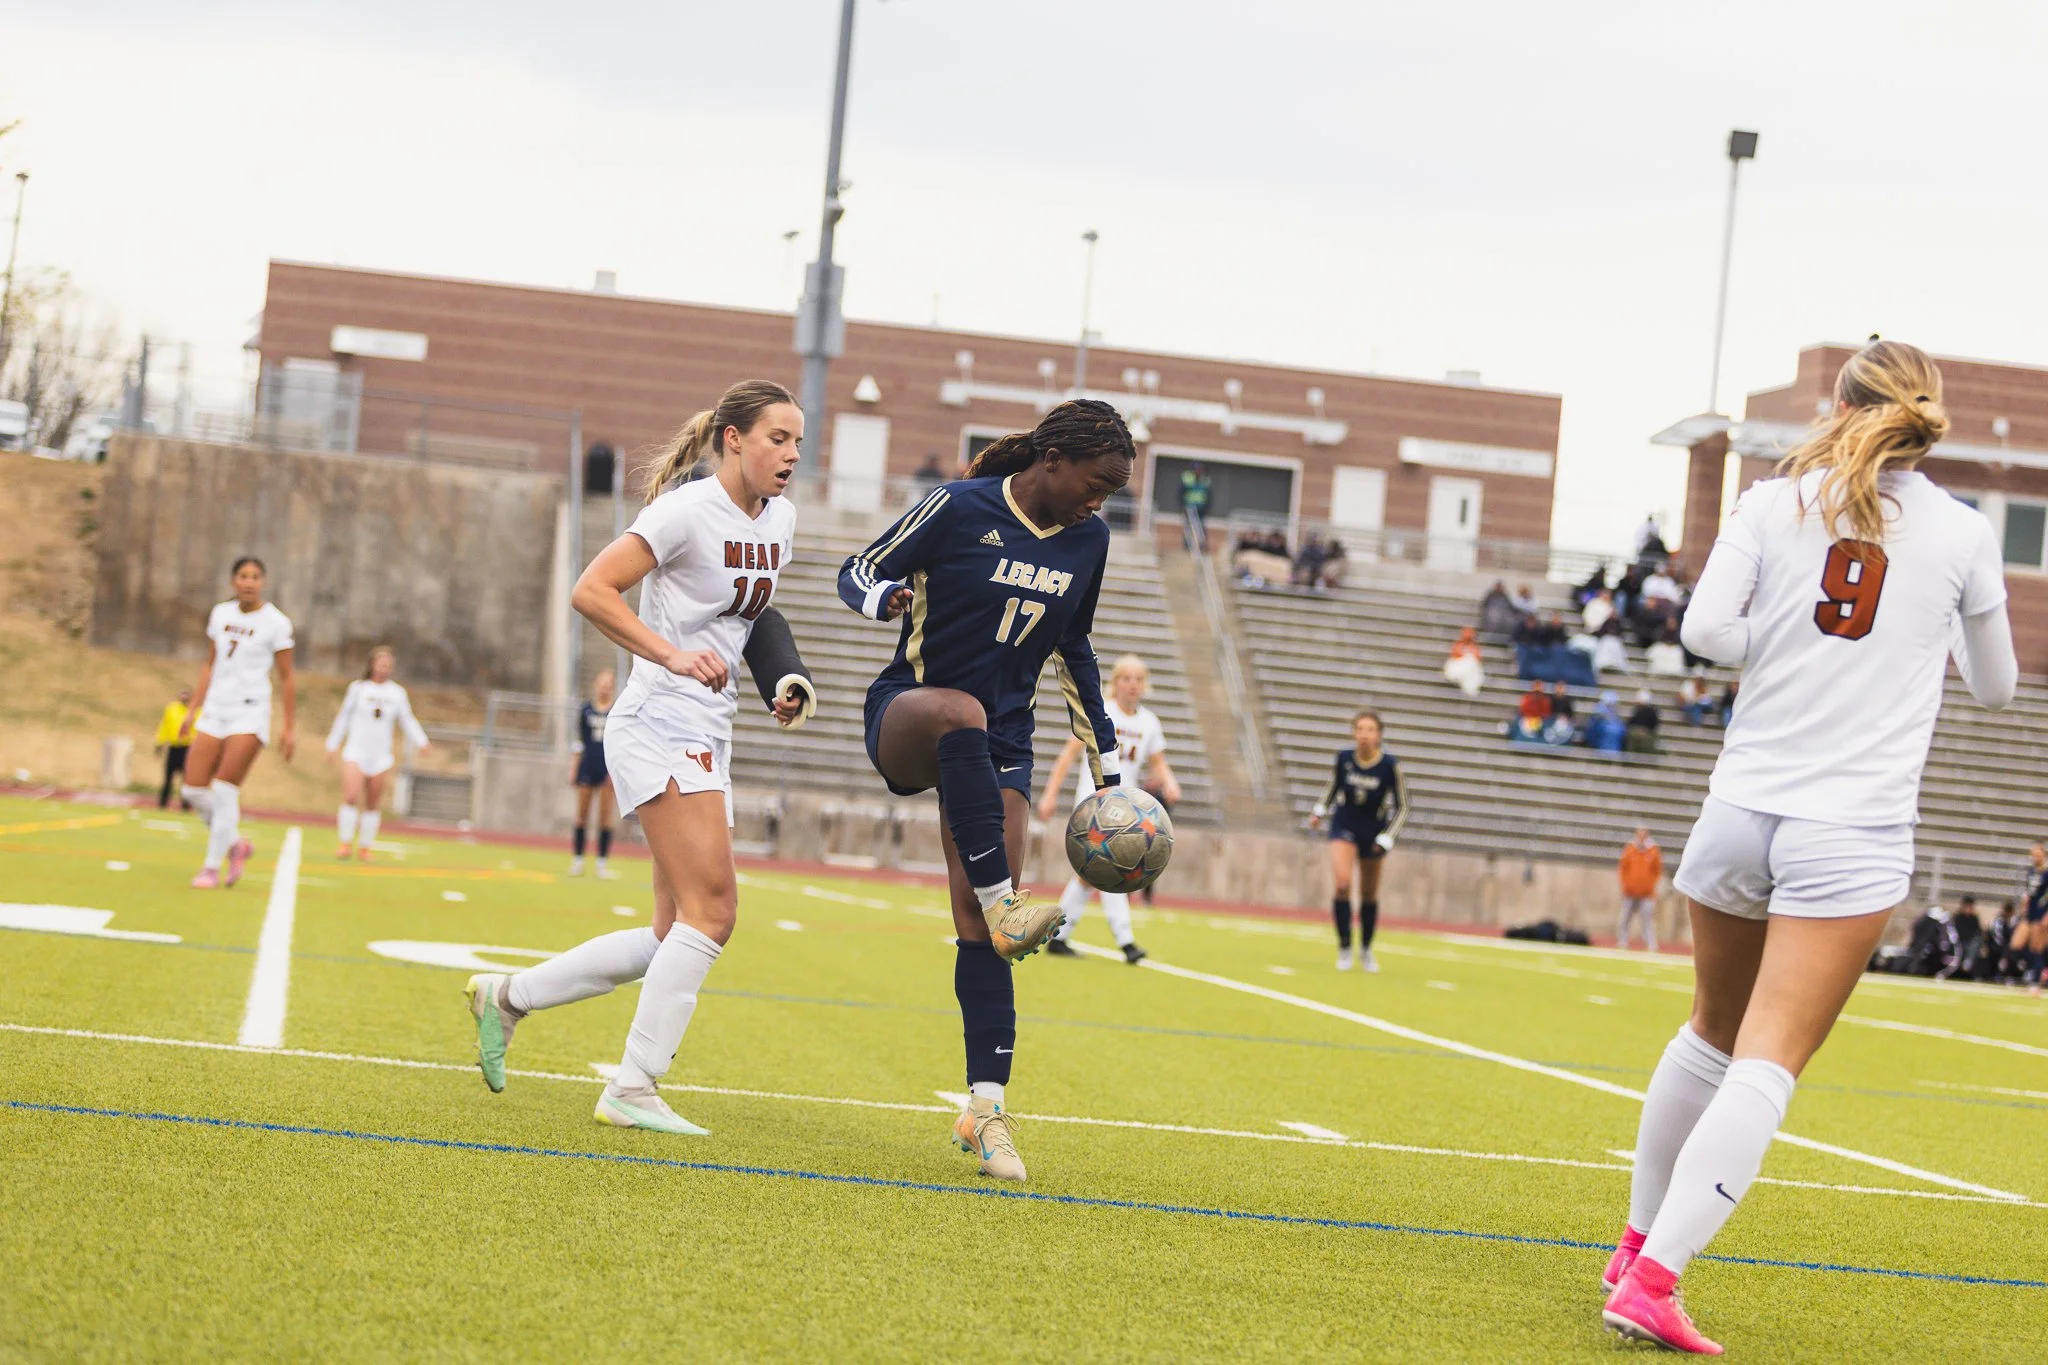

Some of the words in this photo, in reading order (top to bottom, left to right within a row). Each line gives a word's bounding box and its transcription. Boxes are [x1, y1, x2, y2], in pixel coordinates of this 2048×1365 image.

[724, 540, 780, 570] MEAD
[979, 538, 1005, 547] adidas
[988, 557, 1074, 597] LEGACY
[1813, 537, 1889, 641] 9
[716, 576, 773, 621] 10
[995, 597, 1046, 647] 17
